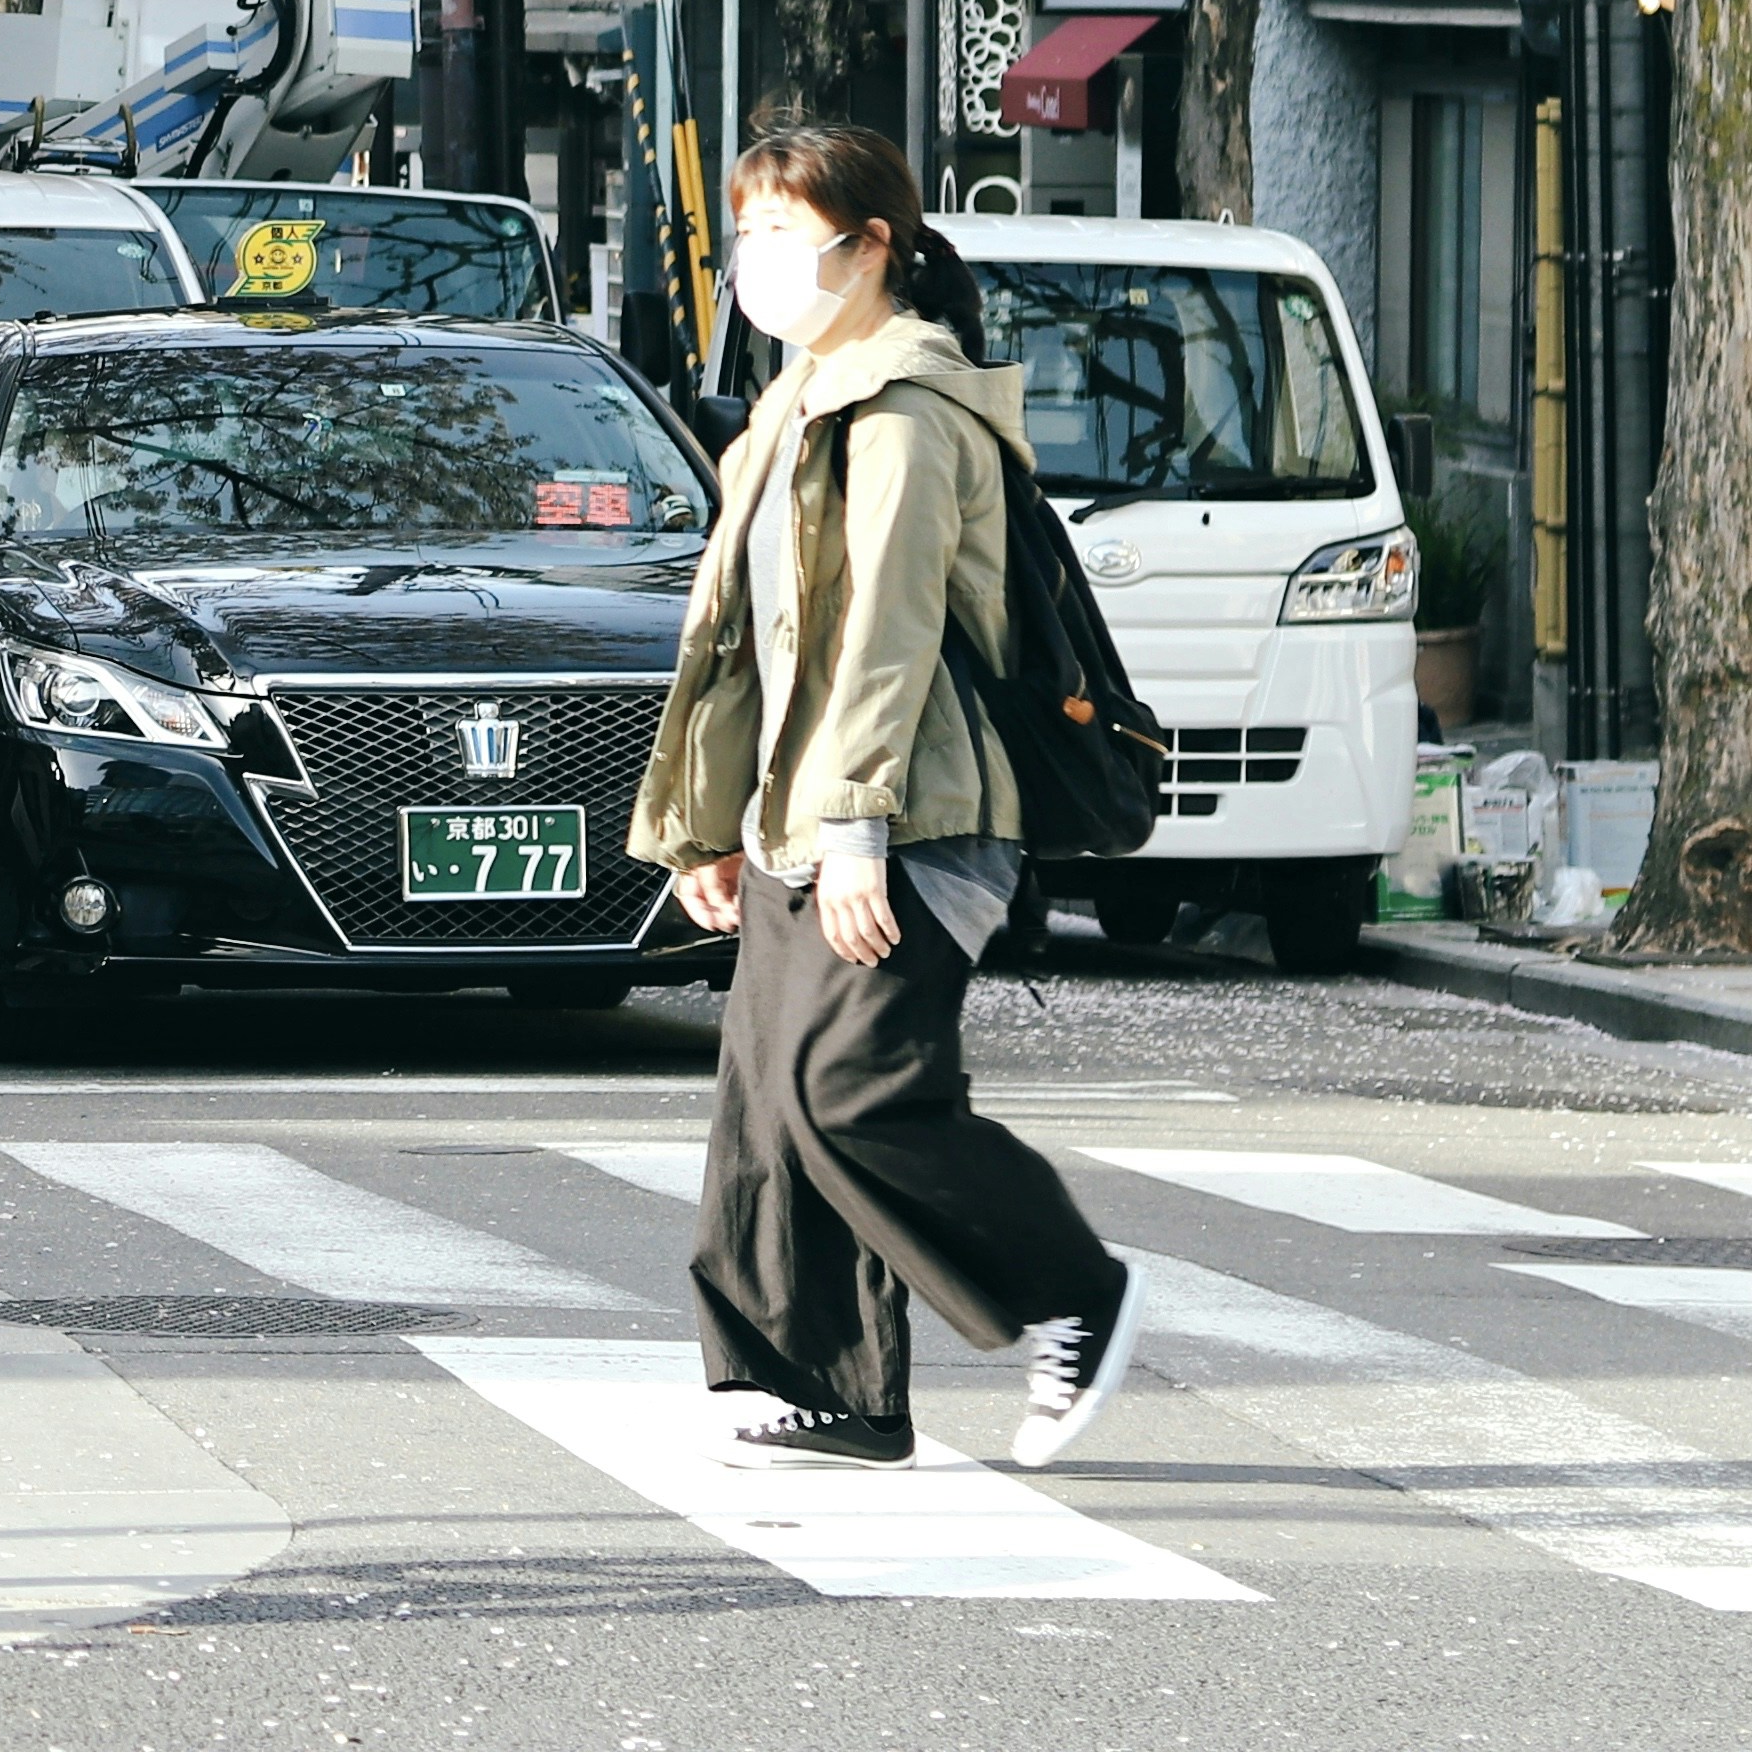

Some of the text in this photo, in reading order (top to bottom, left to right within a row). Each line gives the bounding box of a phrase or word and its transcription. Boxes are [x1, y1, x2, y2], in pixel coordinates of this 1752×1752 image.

[270, 226, 300, 240] 個人
[261, 280, 284, 290] 京都
[536, 482, 632, 527] 空車
